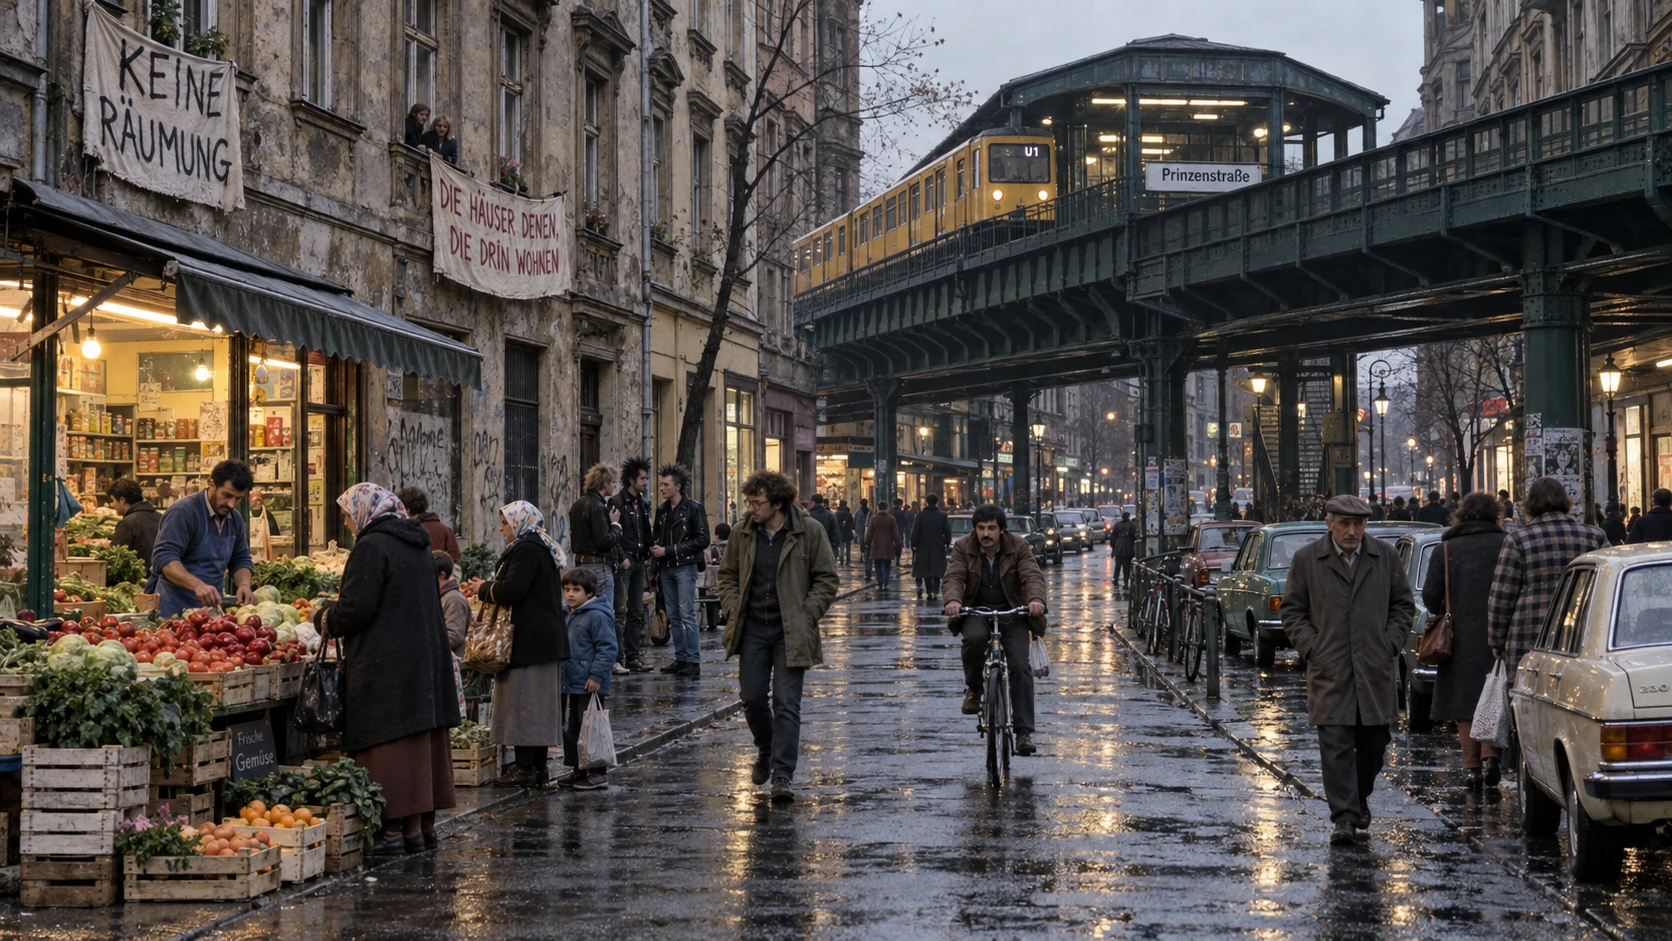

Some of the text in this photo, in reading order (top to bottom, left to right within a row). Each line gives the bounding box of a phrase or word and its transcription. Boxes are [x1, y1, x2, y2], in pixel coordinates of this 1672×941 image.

[119, 39, 223, 117] KEINE
[99, 95, 232, 185] RÄUMUNG
[1025, 146, 1039, 157] U1
[1162, 167, 1250, 183] Prinzenstraße
[440, 178, 559, 242] DIE HÄUSER DENEN,
[450, 225, 472, 262] DIE
[516, 247, 559, 276] WOHNEN
[237, 729, 264, 746] Frische
[236, 750, 275, 772] Gemüse
